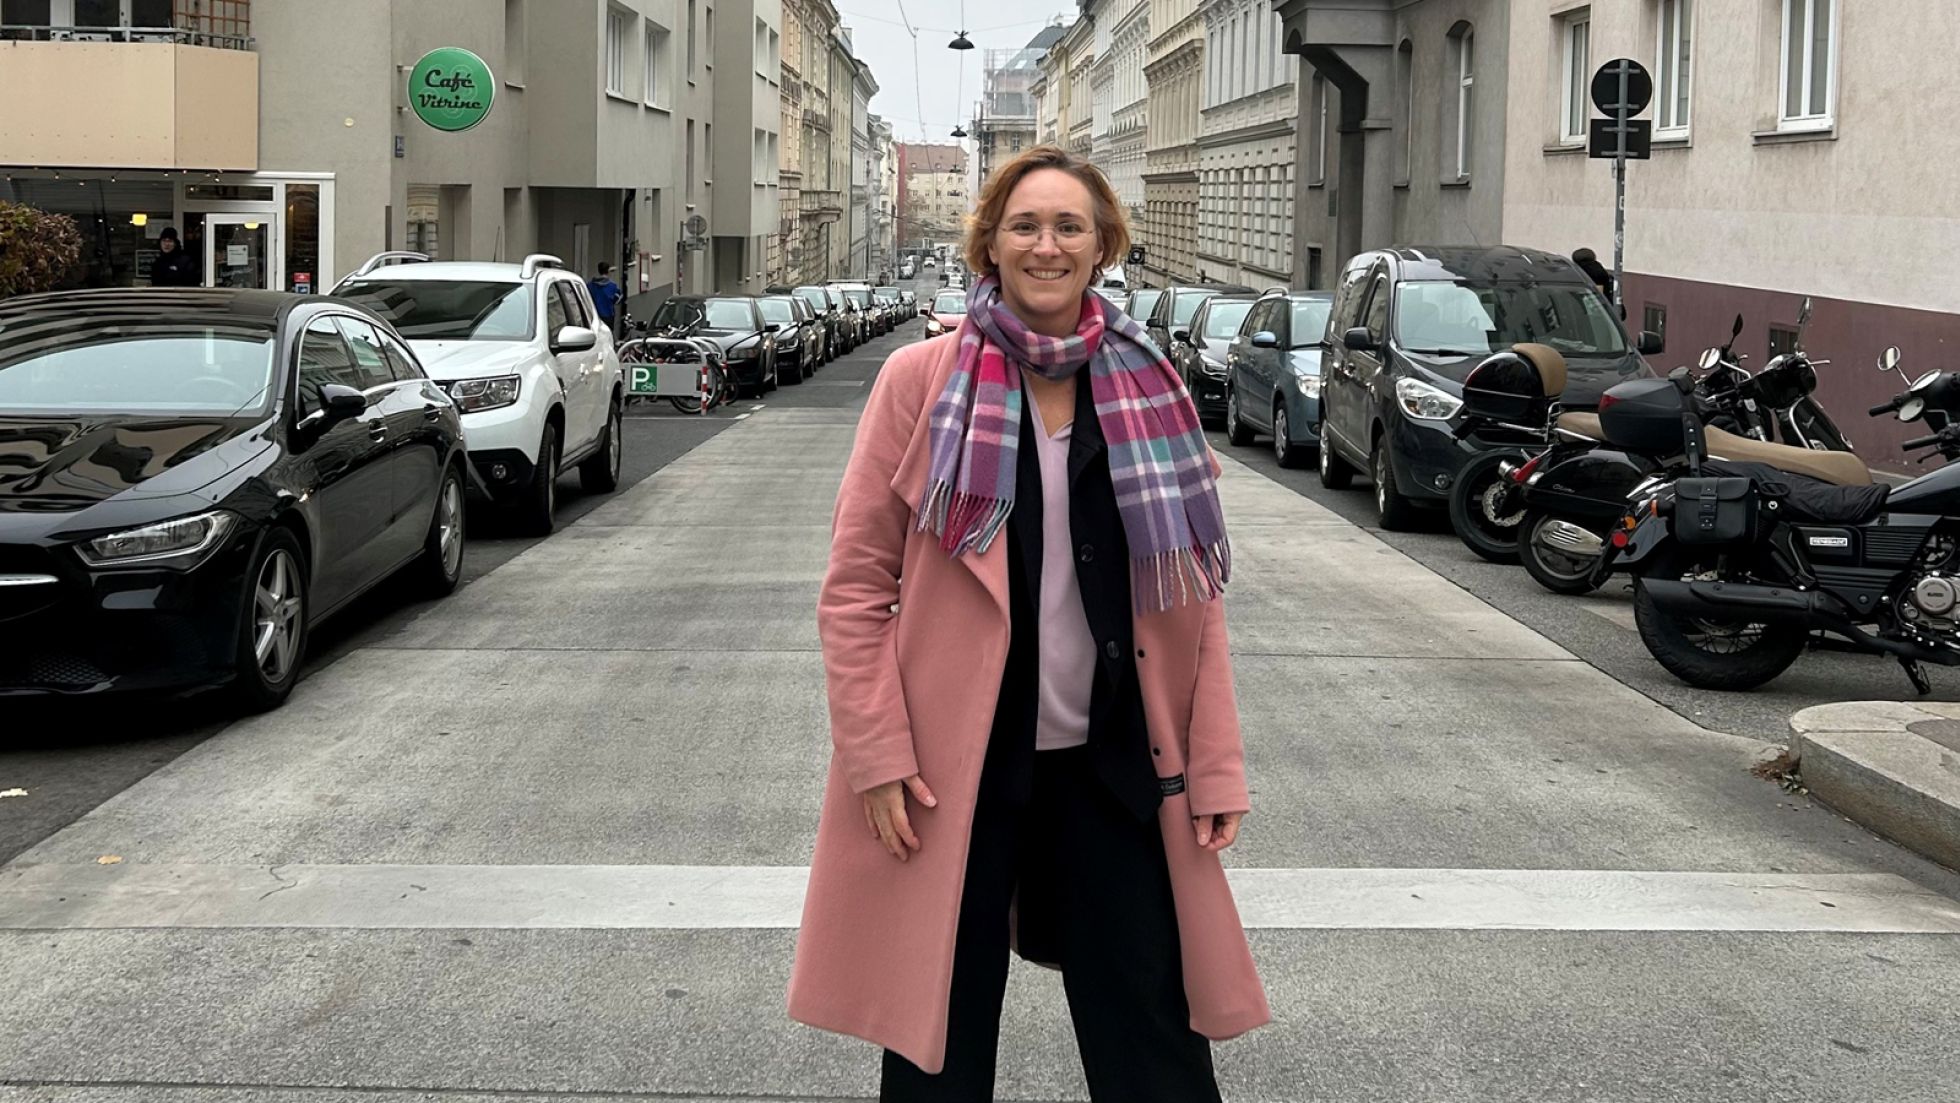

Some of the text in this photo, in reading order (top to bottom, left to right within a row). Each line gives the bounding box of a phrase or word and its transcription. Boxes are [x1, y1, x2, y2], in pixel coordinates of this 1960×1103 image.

[425, 69, 475, 92] Café
[418, 94, 483, 109] Vitrine
[631, 367, 650, 390] P
